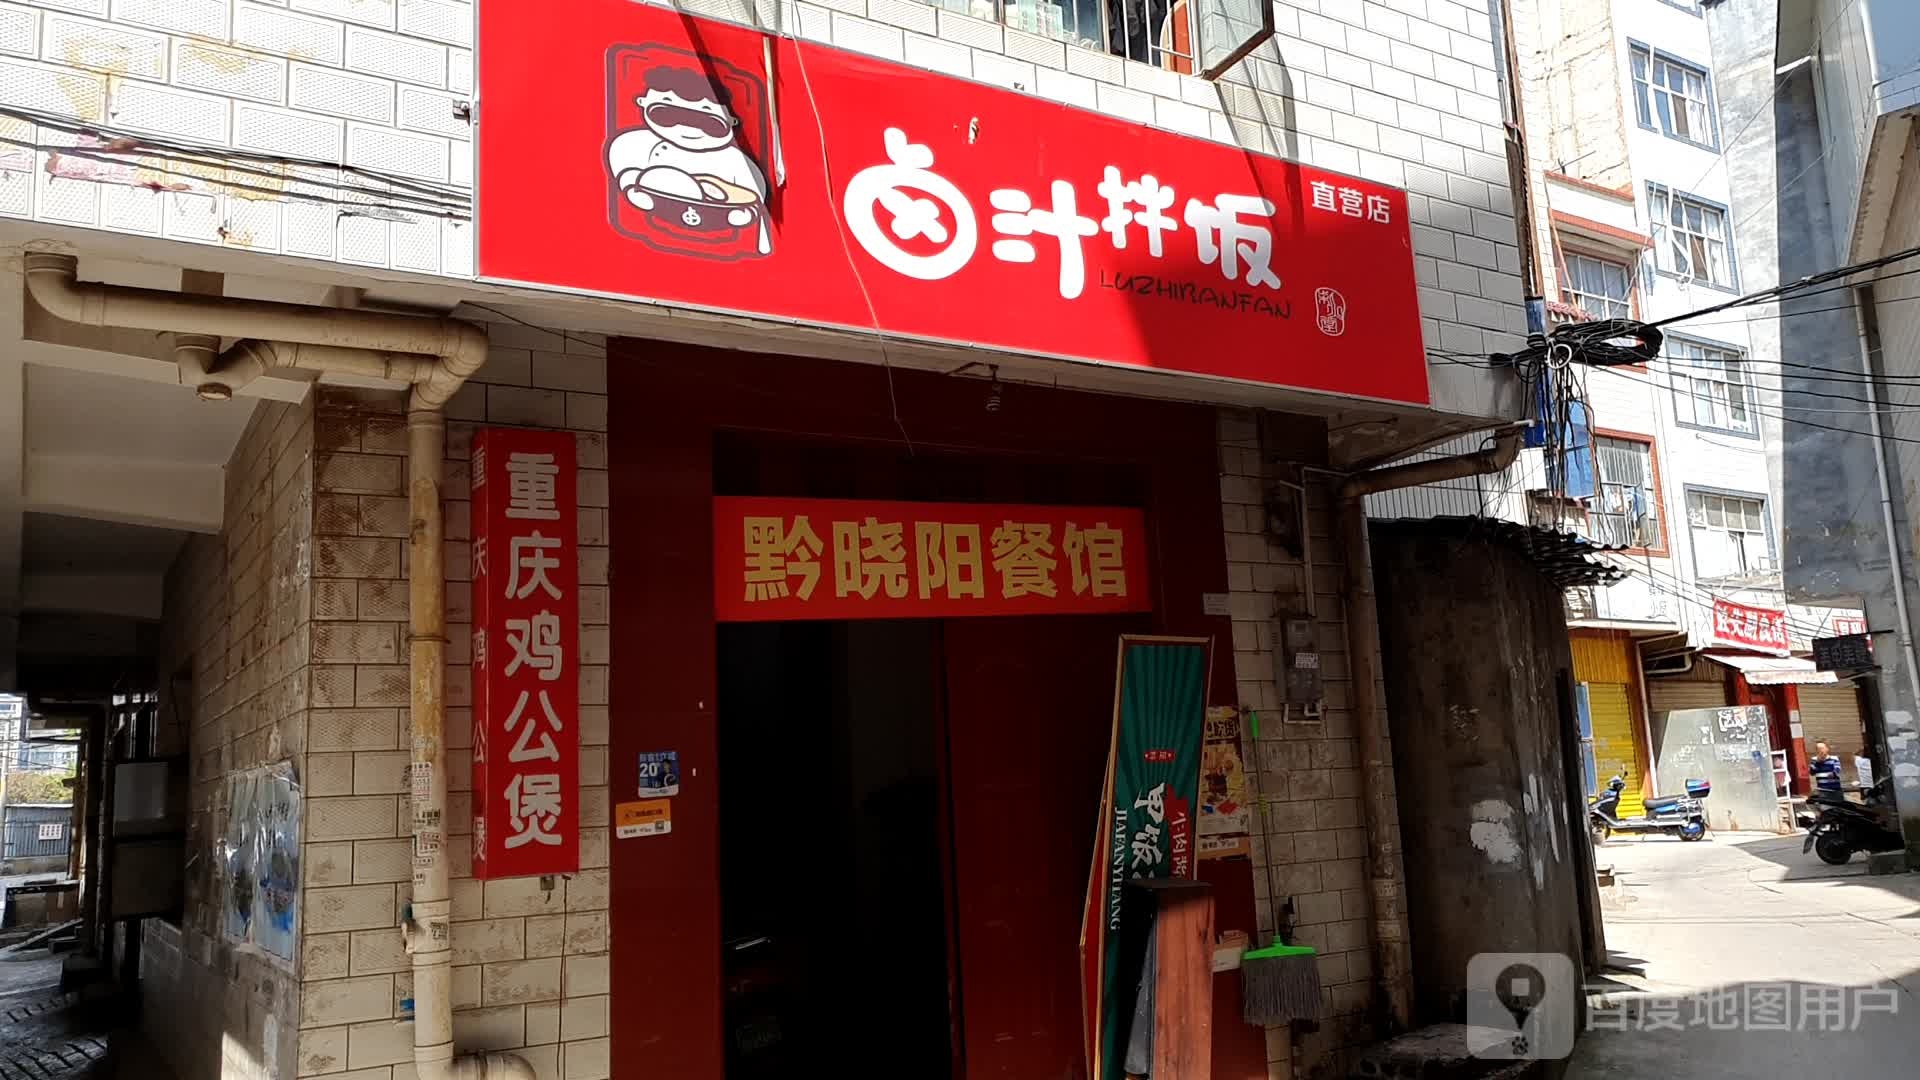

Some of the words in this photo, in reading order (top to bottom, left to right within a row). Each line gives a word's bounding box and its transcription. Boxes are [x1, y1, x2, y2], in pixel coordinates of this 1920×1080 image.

[843, 127, 1283, 300] 卤汁拌饭
[1312, 181, 1391, 224] 直营店
[744, 516, 1128, 601] 黔晓阳餐馆
[503, 452, 563, 849] 重庆鸡公煲
